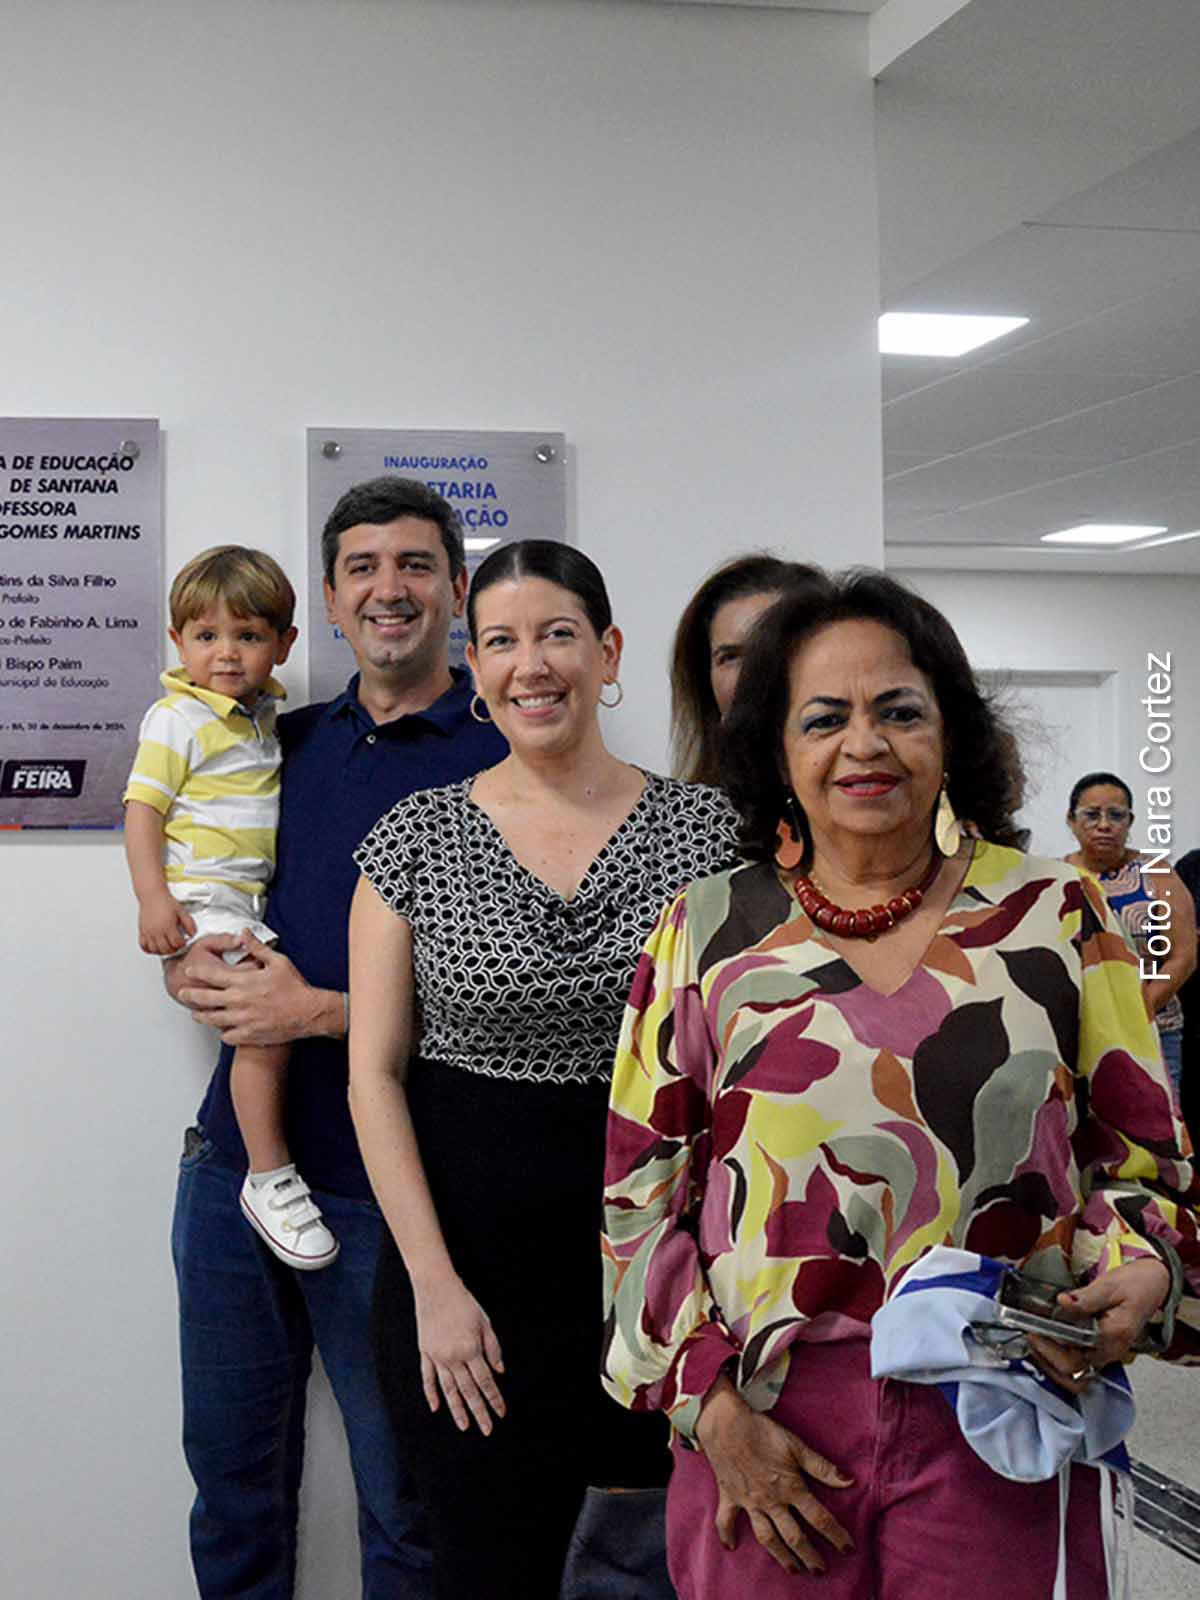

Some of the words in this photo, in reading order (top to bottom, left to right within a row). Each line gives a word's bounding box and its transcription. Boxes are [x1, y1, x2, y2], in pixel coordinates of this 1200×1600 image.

[12, 455, 35, 471] DE
[40, 452, 134, 475] EDUCAÇÃO
[383, 456, 489, 471] INAUGURAÇÃO
[10, 478, 32, 494] DE
[37, 478, 119, 494] SANTANA
[63, 524, 141, 541] MARTINS
[27, 574, 44, 588] da
[48, 574, 79, 588] Silva
[84, 574, 117, 588] Filho
[8, 616, 26, 629] de
[30, 616, 84, 629] Fabinho
[86, 616, 100, 629] A.
[105, 617, 138, 629] Lima
[6, 657, 45, 673] Bispo
[48, 657, 82, 671] Paim
[12, 770, 73, 790] FEIRA
